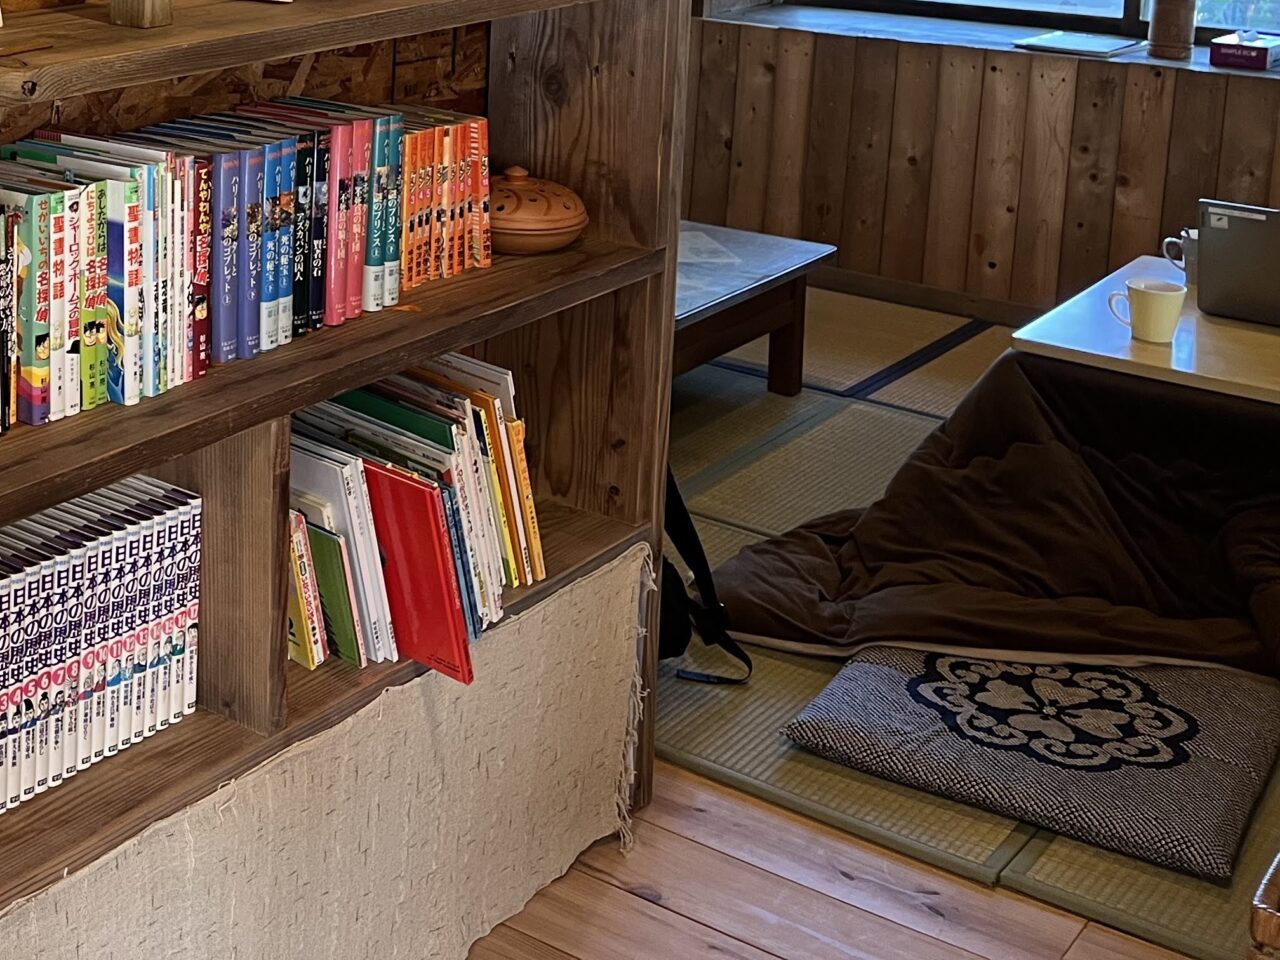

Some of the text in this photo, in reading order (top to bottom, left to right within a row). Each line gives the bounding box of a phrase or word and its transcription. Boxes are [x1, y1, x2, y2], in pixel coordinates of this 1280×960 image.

[35, 200, 49, 324] せかいいちの名探偵
[52, 215, 65, 300] 聖書物語
[83, 191, 97, 310] にちようびは名探偵
[96, 190, 108, 308] あしたからは名探偵
[127, 204, 141, 288] 聖書物語
[194, 168, 210, 285] てんやわんや名探偵
[222, 224, 231, 293] 炎のゴブレット
[248, 222, 257, 288] 炎のゴブレット
[294, 213, 304, 282] アズカバンの囚人
[312, 239, 322, 278] 賢者の石
[372, 191, 384, 248] 謎のプリンス
[386, 189, 398, 243] 謎のプリンス
[82, 554, 98, 651] 日本の歴史
[97, 550, 112, 644] 日本の歴史
[110, 546, 126, 639] 日本の歴史
[124, 540, 139, 634] 日本の歴史
[137, 534, 153, 627] 日本の歴史
[150, 528, 165, 622] 日本の歴史
[163, 524, 177, 617] 日本の歴史
[176, 518, 190, 611] 日本の歴史
[189, 513, 202, 601] 日本の歴史
[10, 588, 26, 686] 日本の歴史
[23, 579, 40, 679] 日本の歴史
[38, 573, 54, 668] 日本の歴史
[53, 568, 69, 664] 日本の歴史
[67, 562, 84, 657] 日本の歴史
